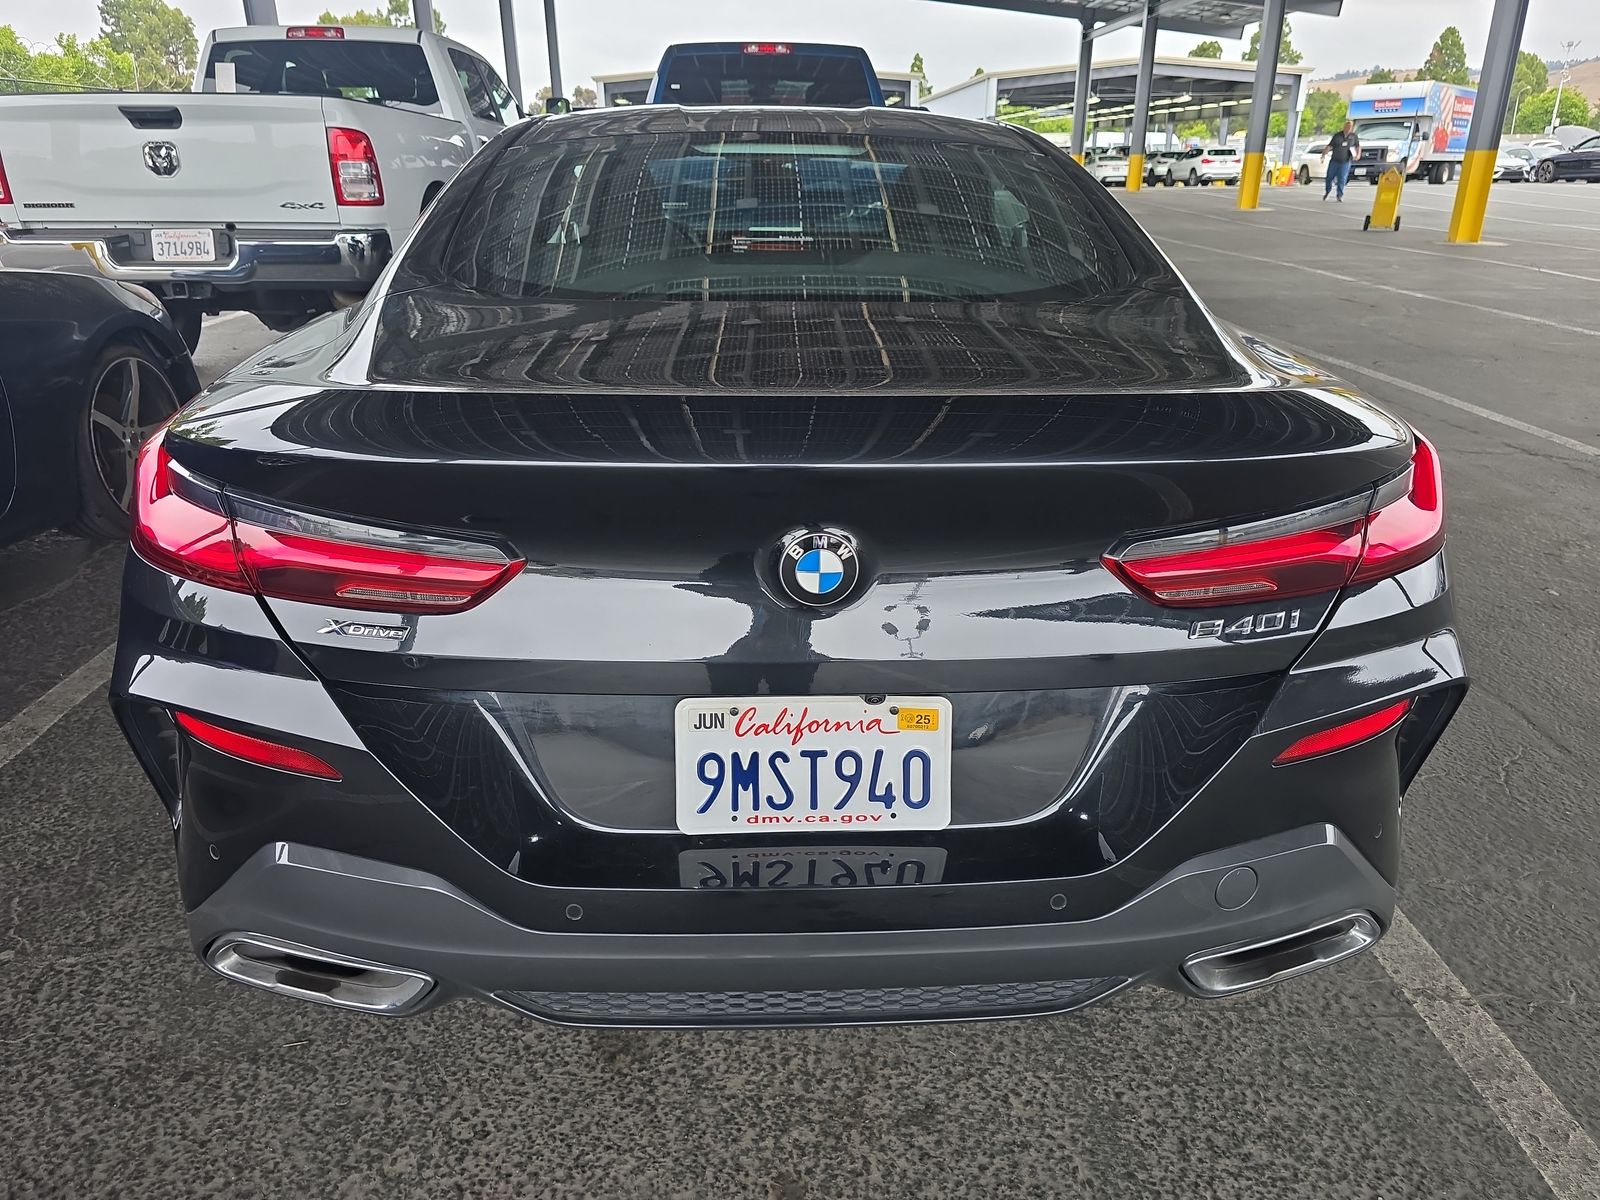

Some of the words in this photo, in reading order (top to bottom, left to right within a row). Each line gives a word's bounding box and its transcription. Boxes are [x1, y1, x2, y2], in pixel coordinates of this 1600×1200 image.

[156, 240, 210, 257] 37149B4
[787, 535, 854, 561] BMW
[693, 712, 726, 731] JUN
[734, 706, 901, 746] California
[915, 714, 931, 725] 25
[696, 749, 932, 815] 9MST940
[746, 814, 883, 825] dmv.ca.gov
